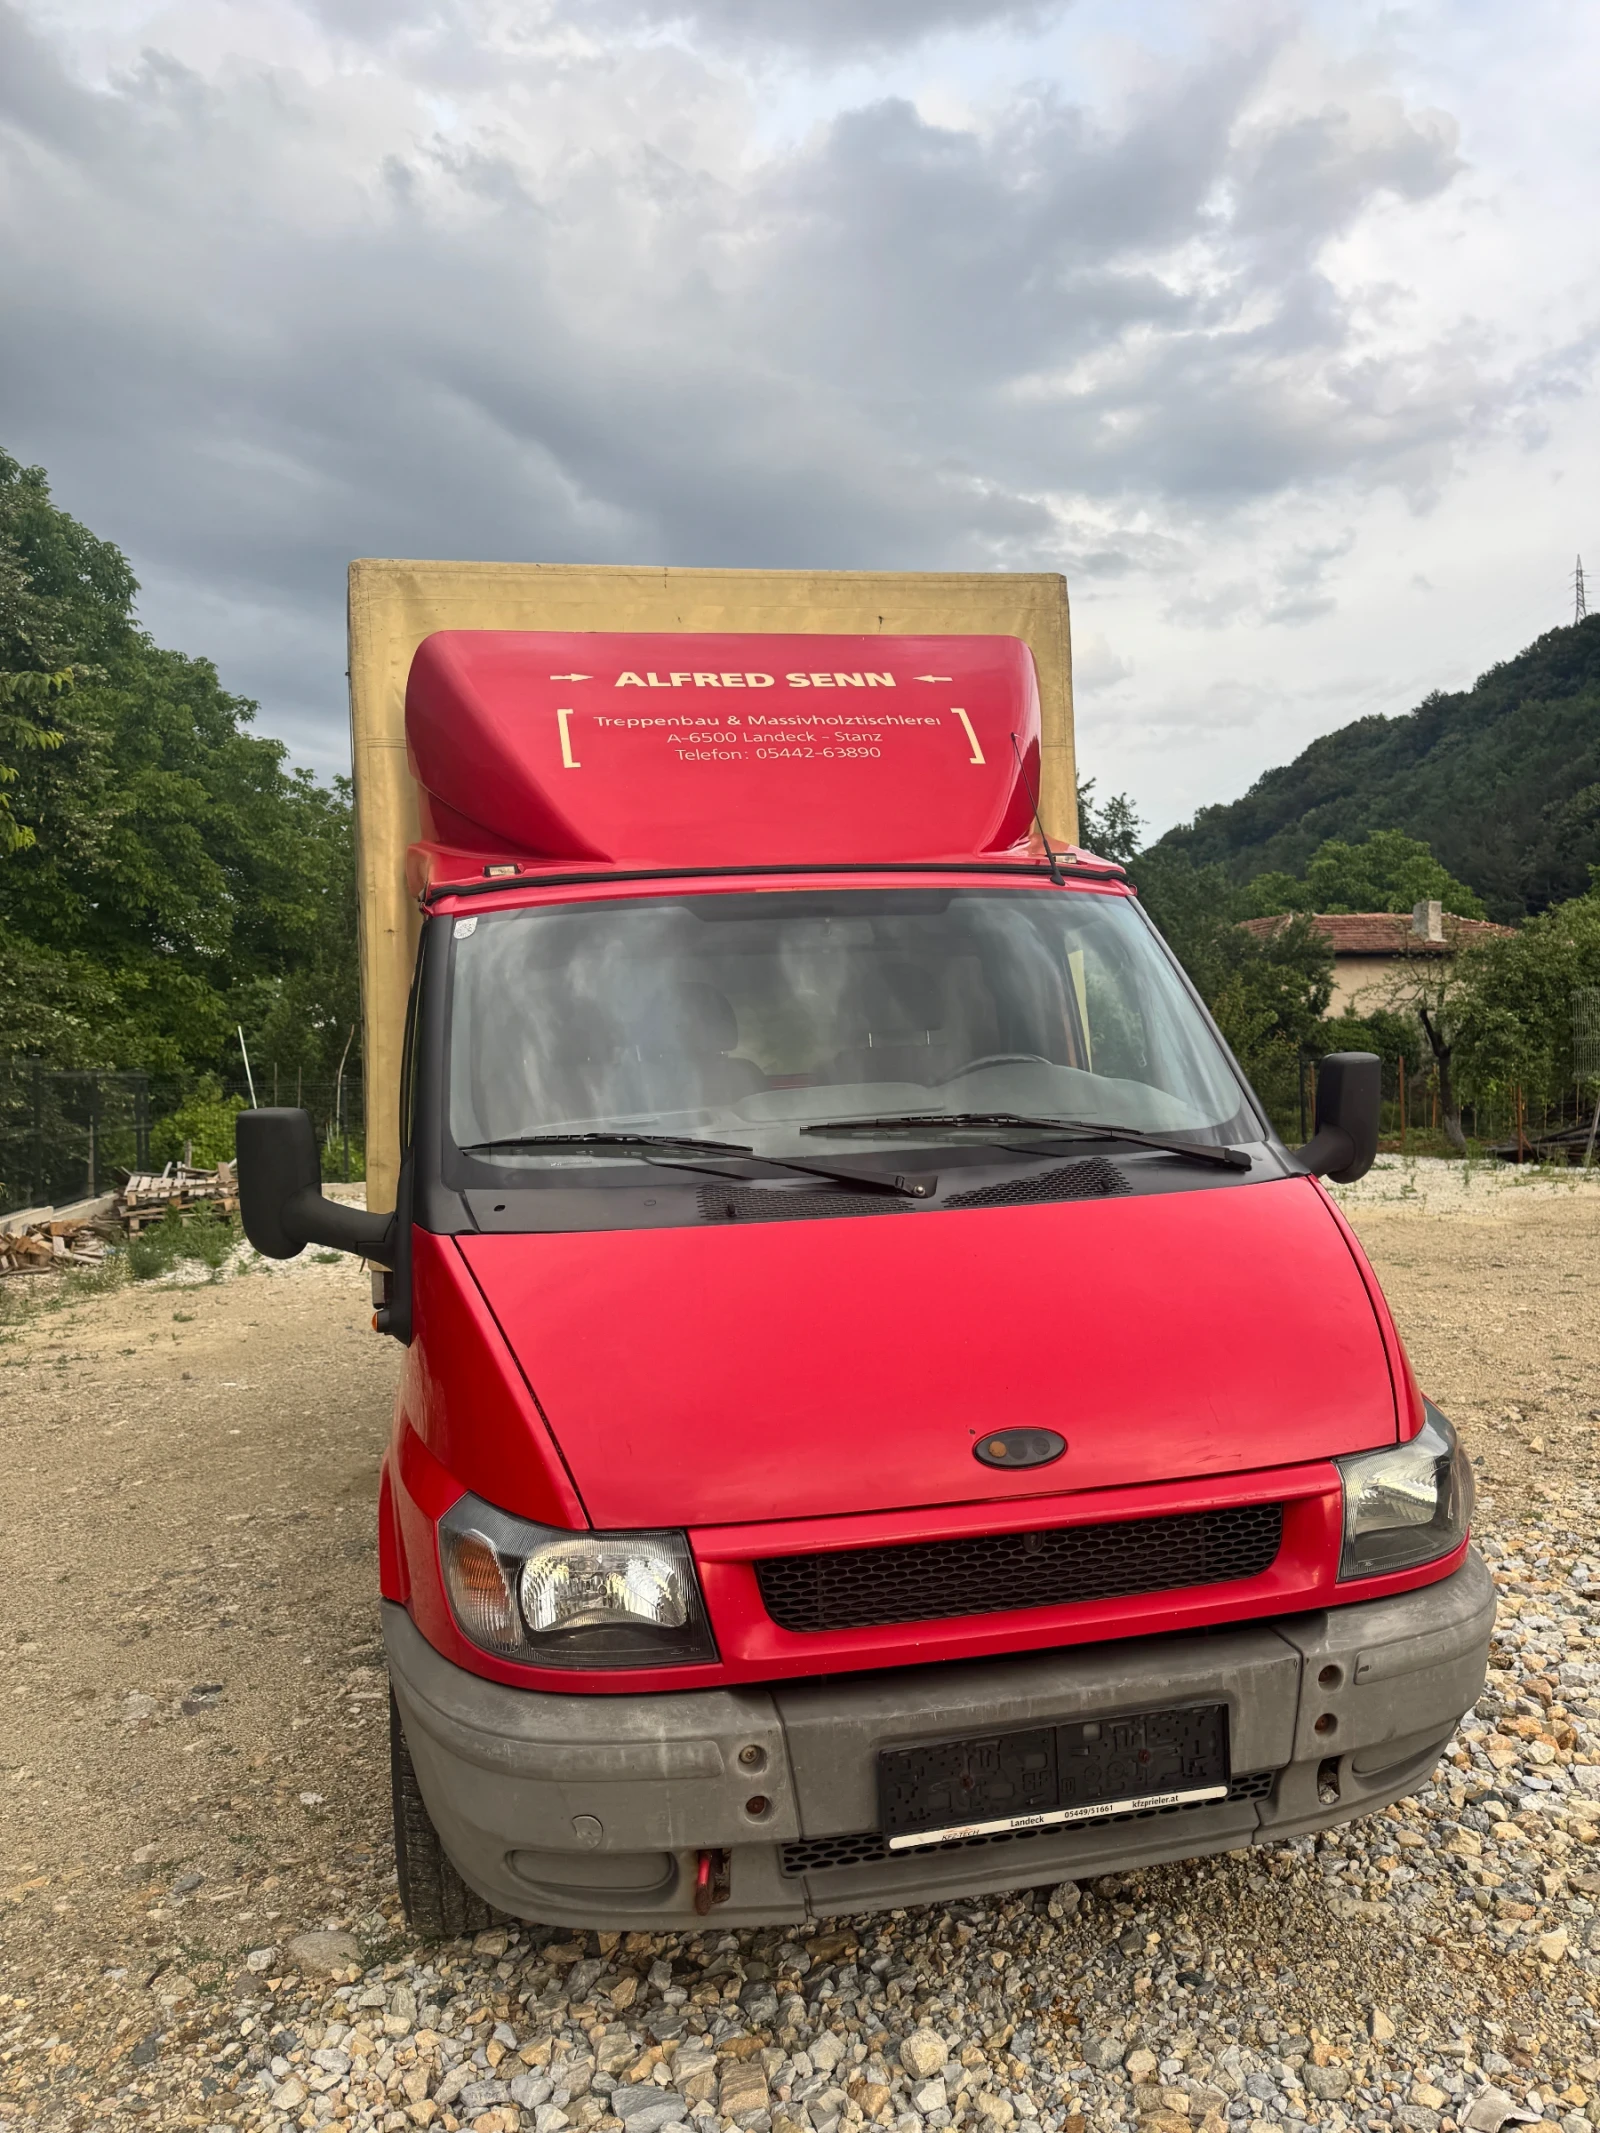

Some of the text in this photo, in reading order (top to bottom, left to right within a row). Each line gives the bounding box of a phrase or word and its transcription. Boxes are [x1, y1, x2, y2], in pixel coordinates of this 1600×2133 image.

[614, 671, 897, 688] ALFRED SENN
[593, 714, 942, 729] Treppenbau & Massivholztischlerei
[666, 731, 737, 744] A-6500
[743, 731, 818, 744] Landeck
[834, 731, 884, 743] Stanz
[674, 746, 882, 761] Telefon: 05442-63890
[941, 1795, 1180, 1841] KFZ-TECH Landeck 05449/51661 kfzprieler.at
